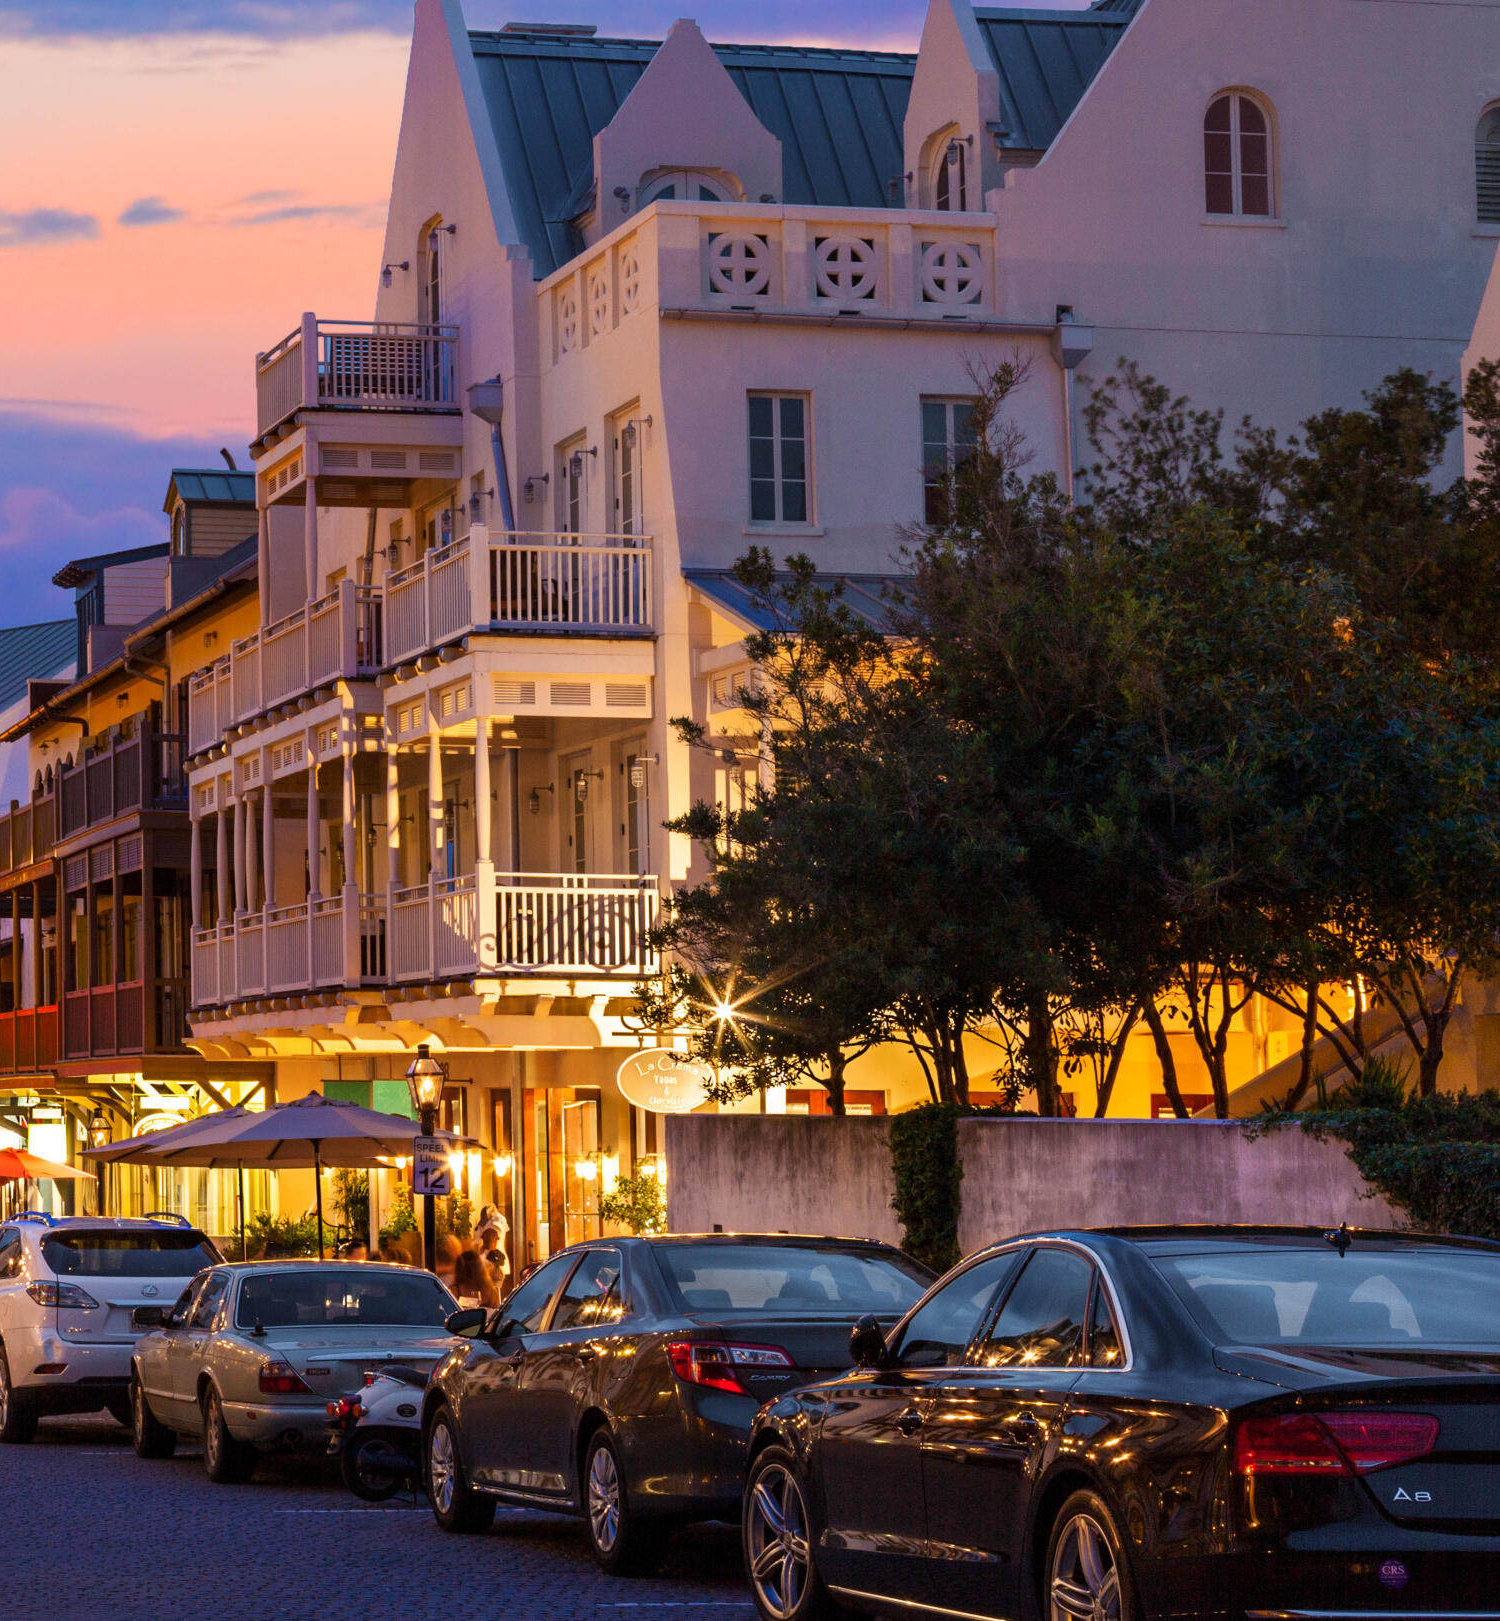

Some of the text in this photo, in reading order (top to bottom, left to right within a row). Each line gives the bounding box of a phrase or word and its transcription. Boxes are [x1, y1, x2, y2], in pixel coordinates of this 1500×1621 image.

[635, 1063, 655, 1076] La
[419, 1167, 445, 1189] 12
[1393, 1487, 1432, 1502] A8
[1381, 1565, 1405, 1575] CRS
